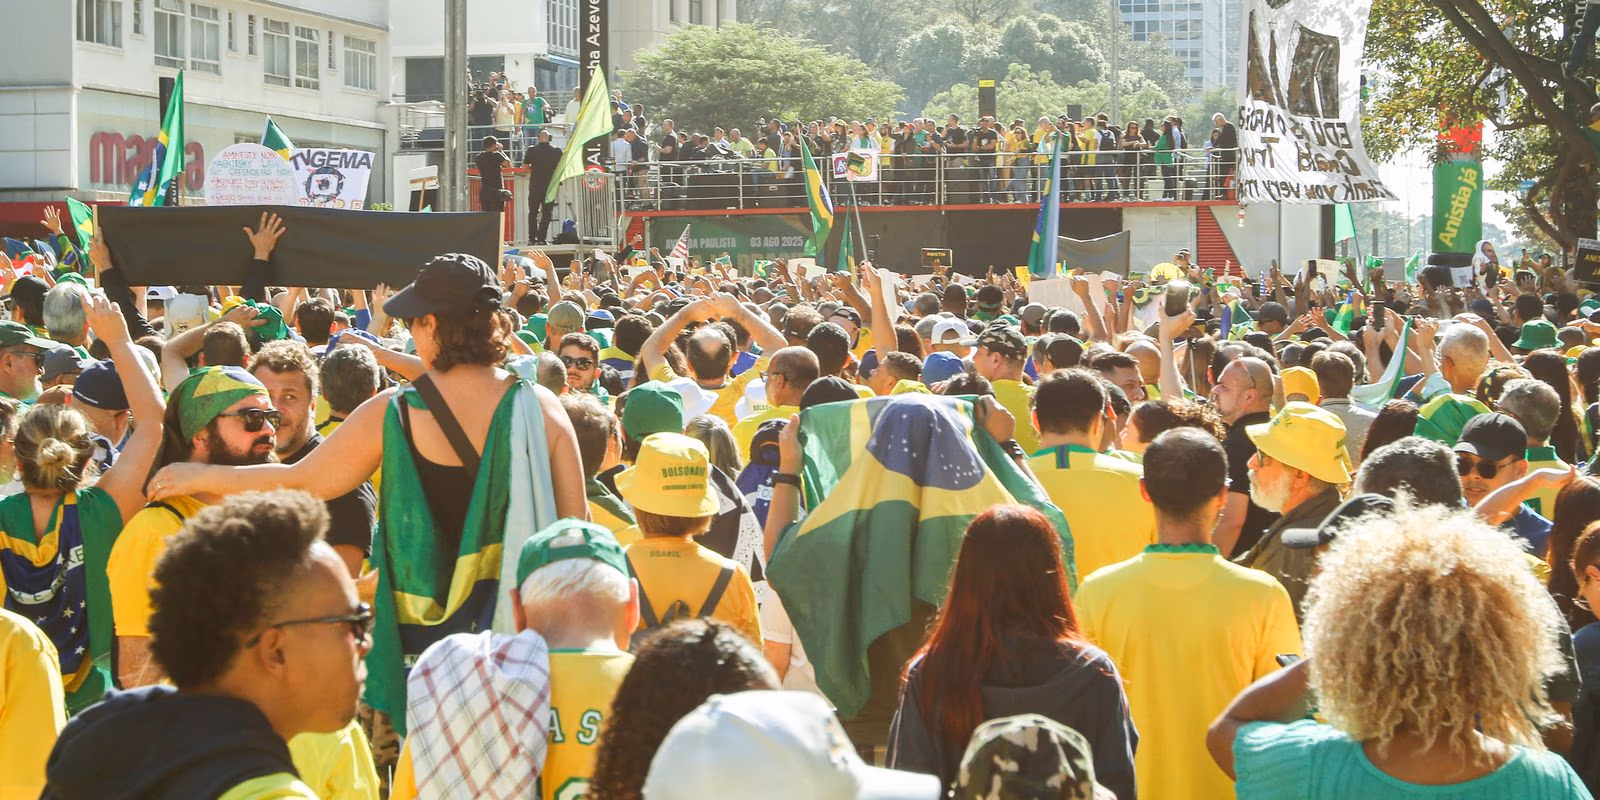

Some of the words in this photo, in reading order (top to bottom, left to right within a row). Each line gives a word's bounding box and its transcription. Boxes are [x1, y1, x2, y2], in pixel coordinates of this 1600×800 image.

[90, 131, 204, 191] mara
[700, 238, 737, 249] PAULISTA
[750, 237, 762, 247] 03
[763, 236, 780, 247] AGO
[781, 235, 804, 247] 2025
[1439, 186, 1473, 247] Anistia
